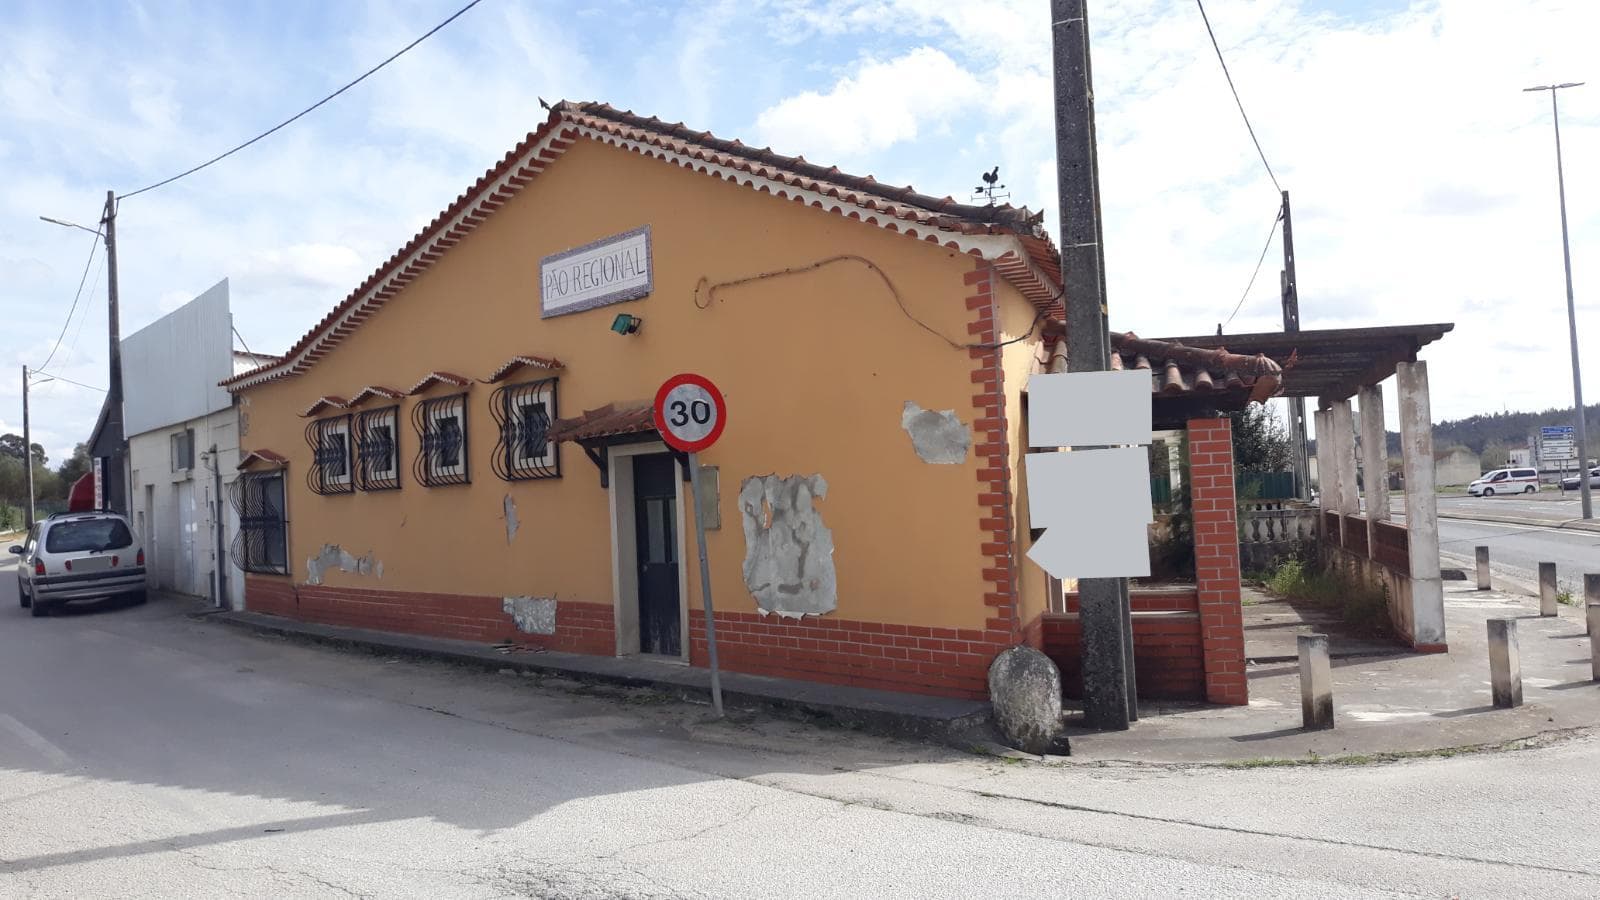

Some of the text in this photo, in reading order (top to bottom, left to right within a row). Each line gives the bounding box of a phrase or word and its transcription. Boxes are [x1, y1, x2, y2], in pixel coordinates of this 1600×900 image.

[545, 247, 646, 300] PÃO REGIONAL
[670, 400, 711, 427] 30
